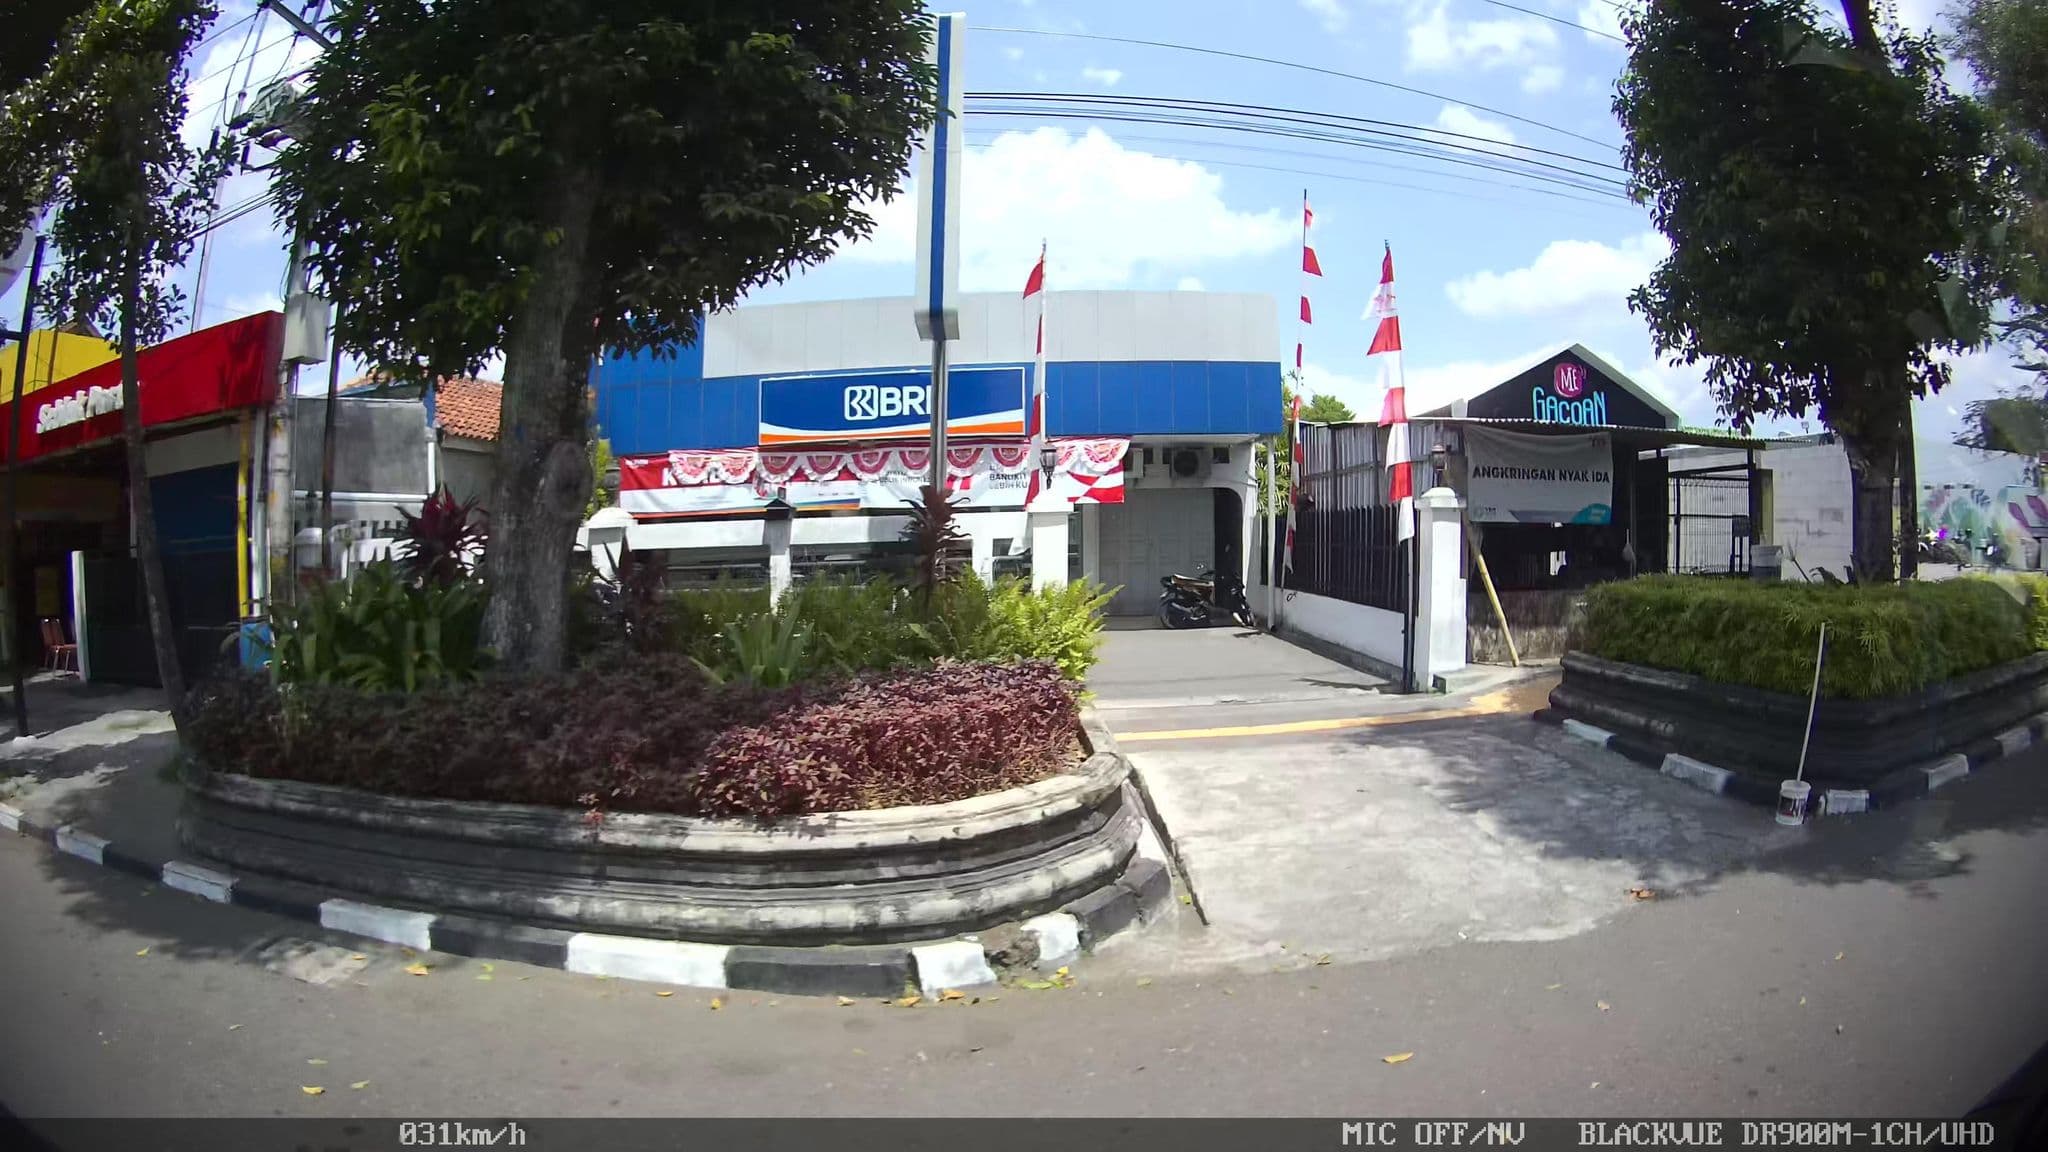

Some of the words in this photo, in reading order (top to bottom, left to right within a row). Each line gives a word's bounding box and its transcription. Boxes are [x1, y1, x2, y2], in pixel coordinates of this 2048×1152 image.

[1560, 367, 1579, 391] MIE
[880, 385, 932, 417] BRI
[1532, 386, 1606, 426] GACOAN
[1472, 464, 1556, 481] ANGKRINGAN
[1559, 469, 1589, 482] NYAK
[1592, 471, 1610, 483] IDA
